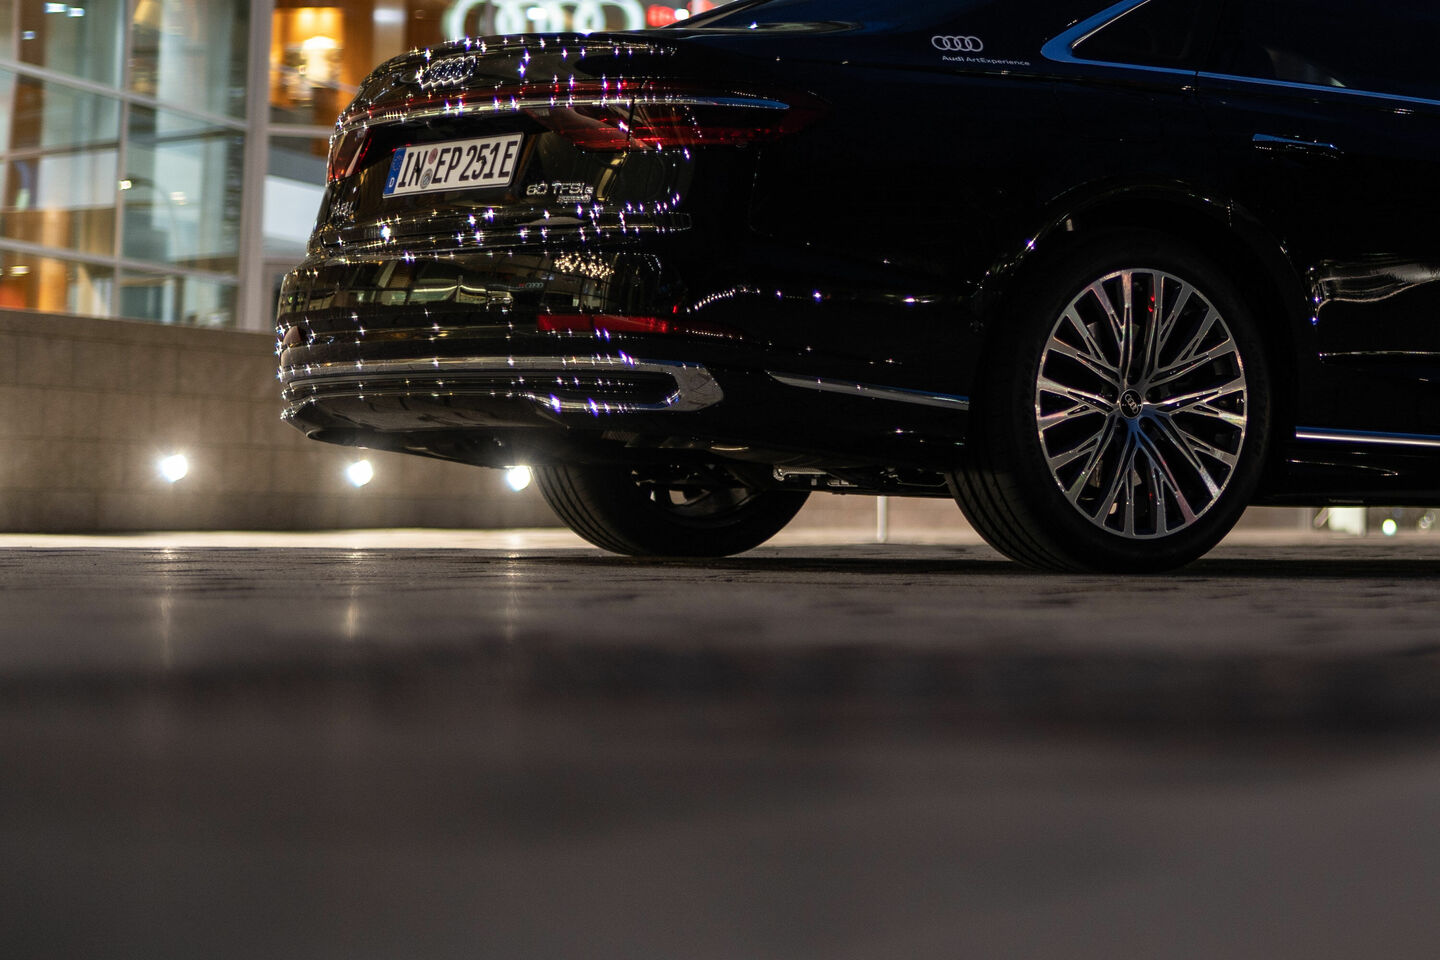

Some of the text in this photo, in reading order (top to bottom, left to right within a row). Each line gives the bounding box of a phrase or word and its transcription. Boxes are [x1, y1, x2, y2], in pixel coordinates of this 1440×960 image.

[397, 140, 518, 188] IN EP 251E
[388, 178, 395, 188] D
[525, 182, 548, 196] 60
